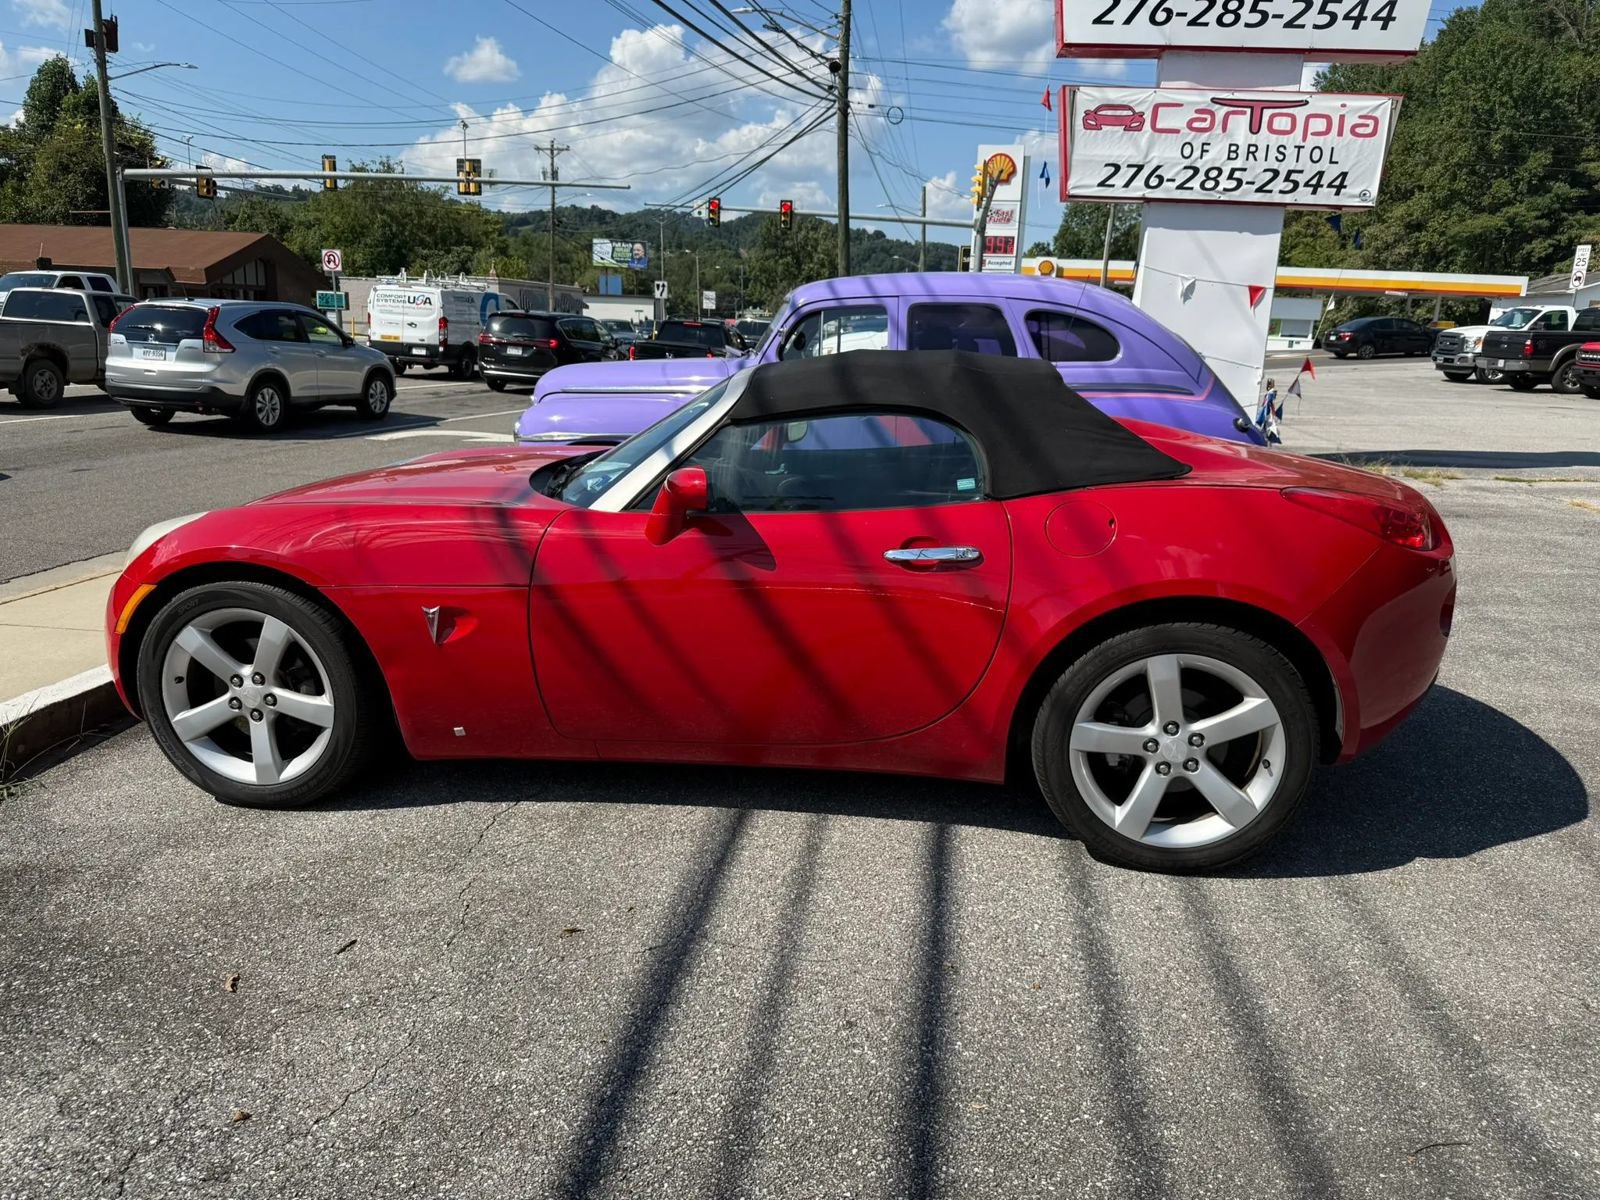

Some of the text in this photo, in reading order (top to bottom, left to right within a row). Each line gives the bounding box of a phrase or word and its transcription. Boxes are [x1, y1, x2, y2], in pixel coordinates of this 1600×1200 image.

[1091, 0, 1397, 31] 276-285-2544
[1150, 98, 1380, 143] CarTopia
[1180, 142, 1340, 165] OF BRISTOL
[1096, 163, 1349, 196] 276-285-2544
[1576, 257, 1587, 267] 25
[407, 294, 433, 306] USA
